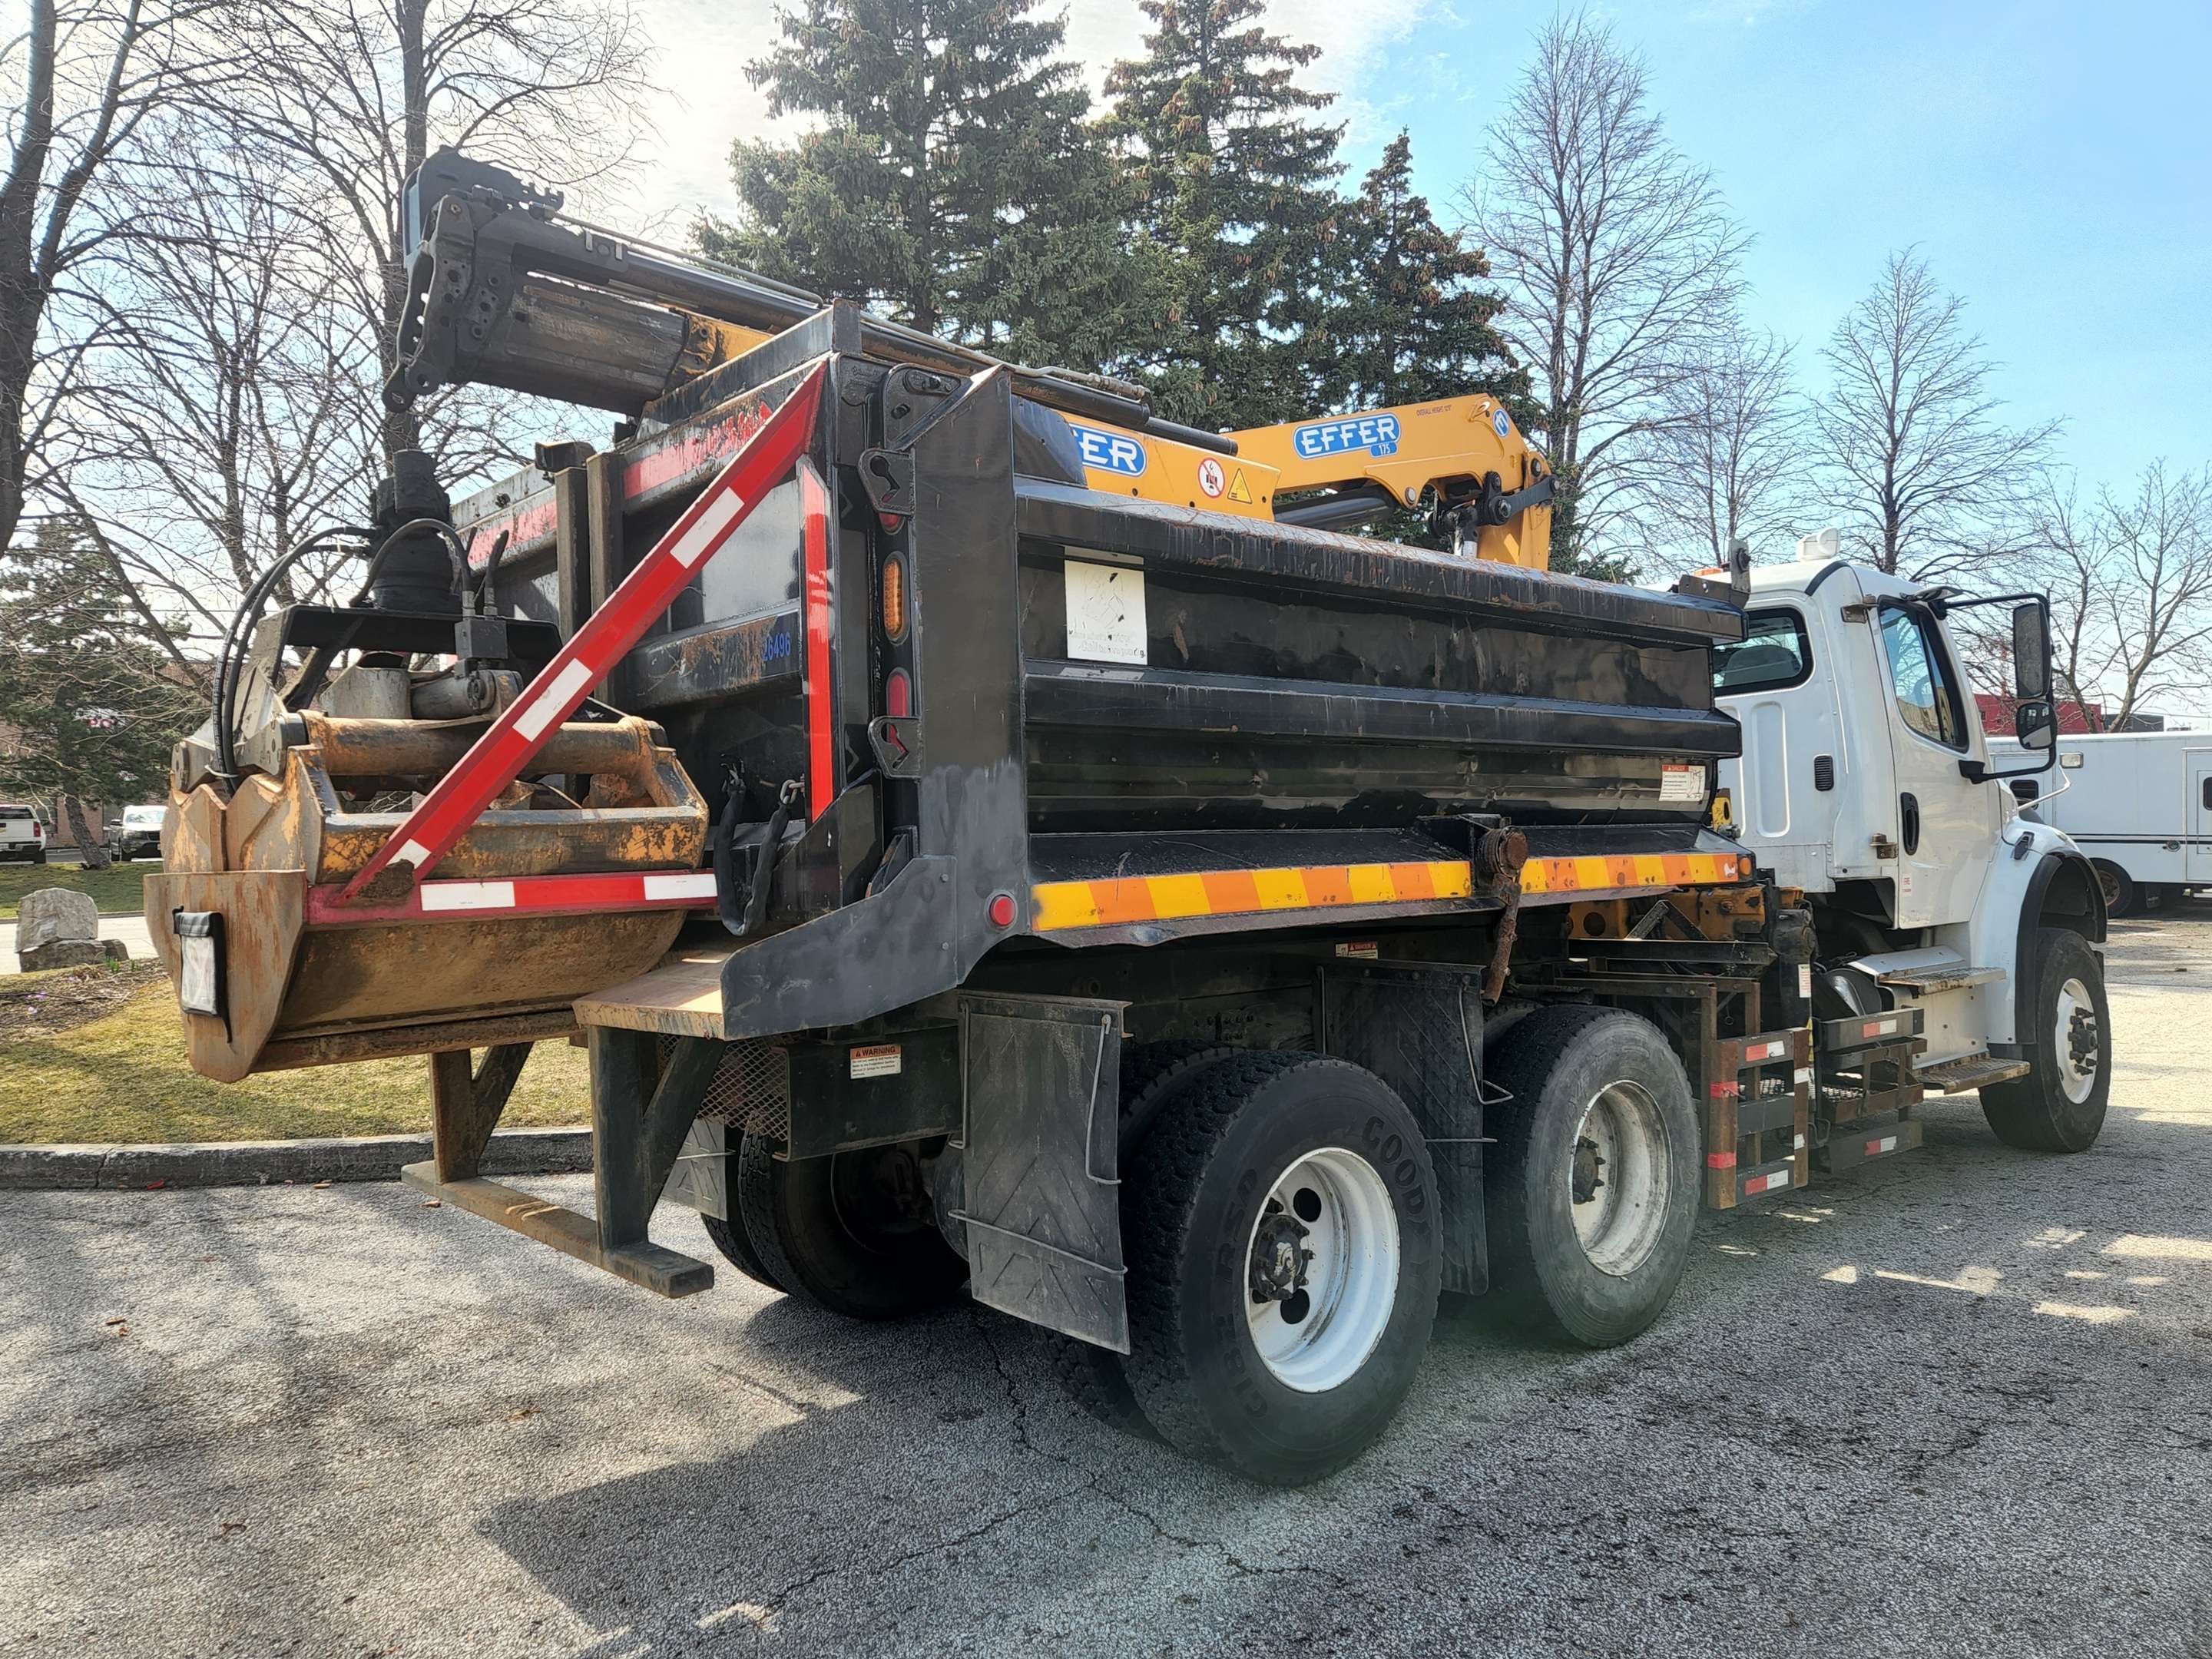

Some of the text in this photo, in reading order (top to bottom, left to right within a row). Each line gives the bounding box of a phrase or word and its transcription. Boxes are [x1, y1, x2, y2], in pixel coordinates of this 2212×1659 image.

[1300, 417, 1397, 455] EFFER
[1073, 429, 1137, 472] ER
[1378, 443, 1391, 455] 175
[862, 1045, 896, 1056] WARNING
